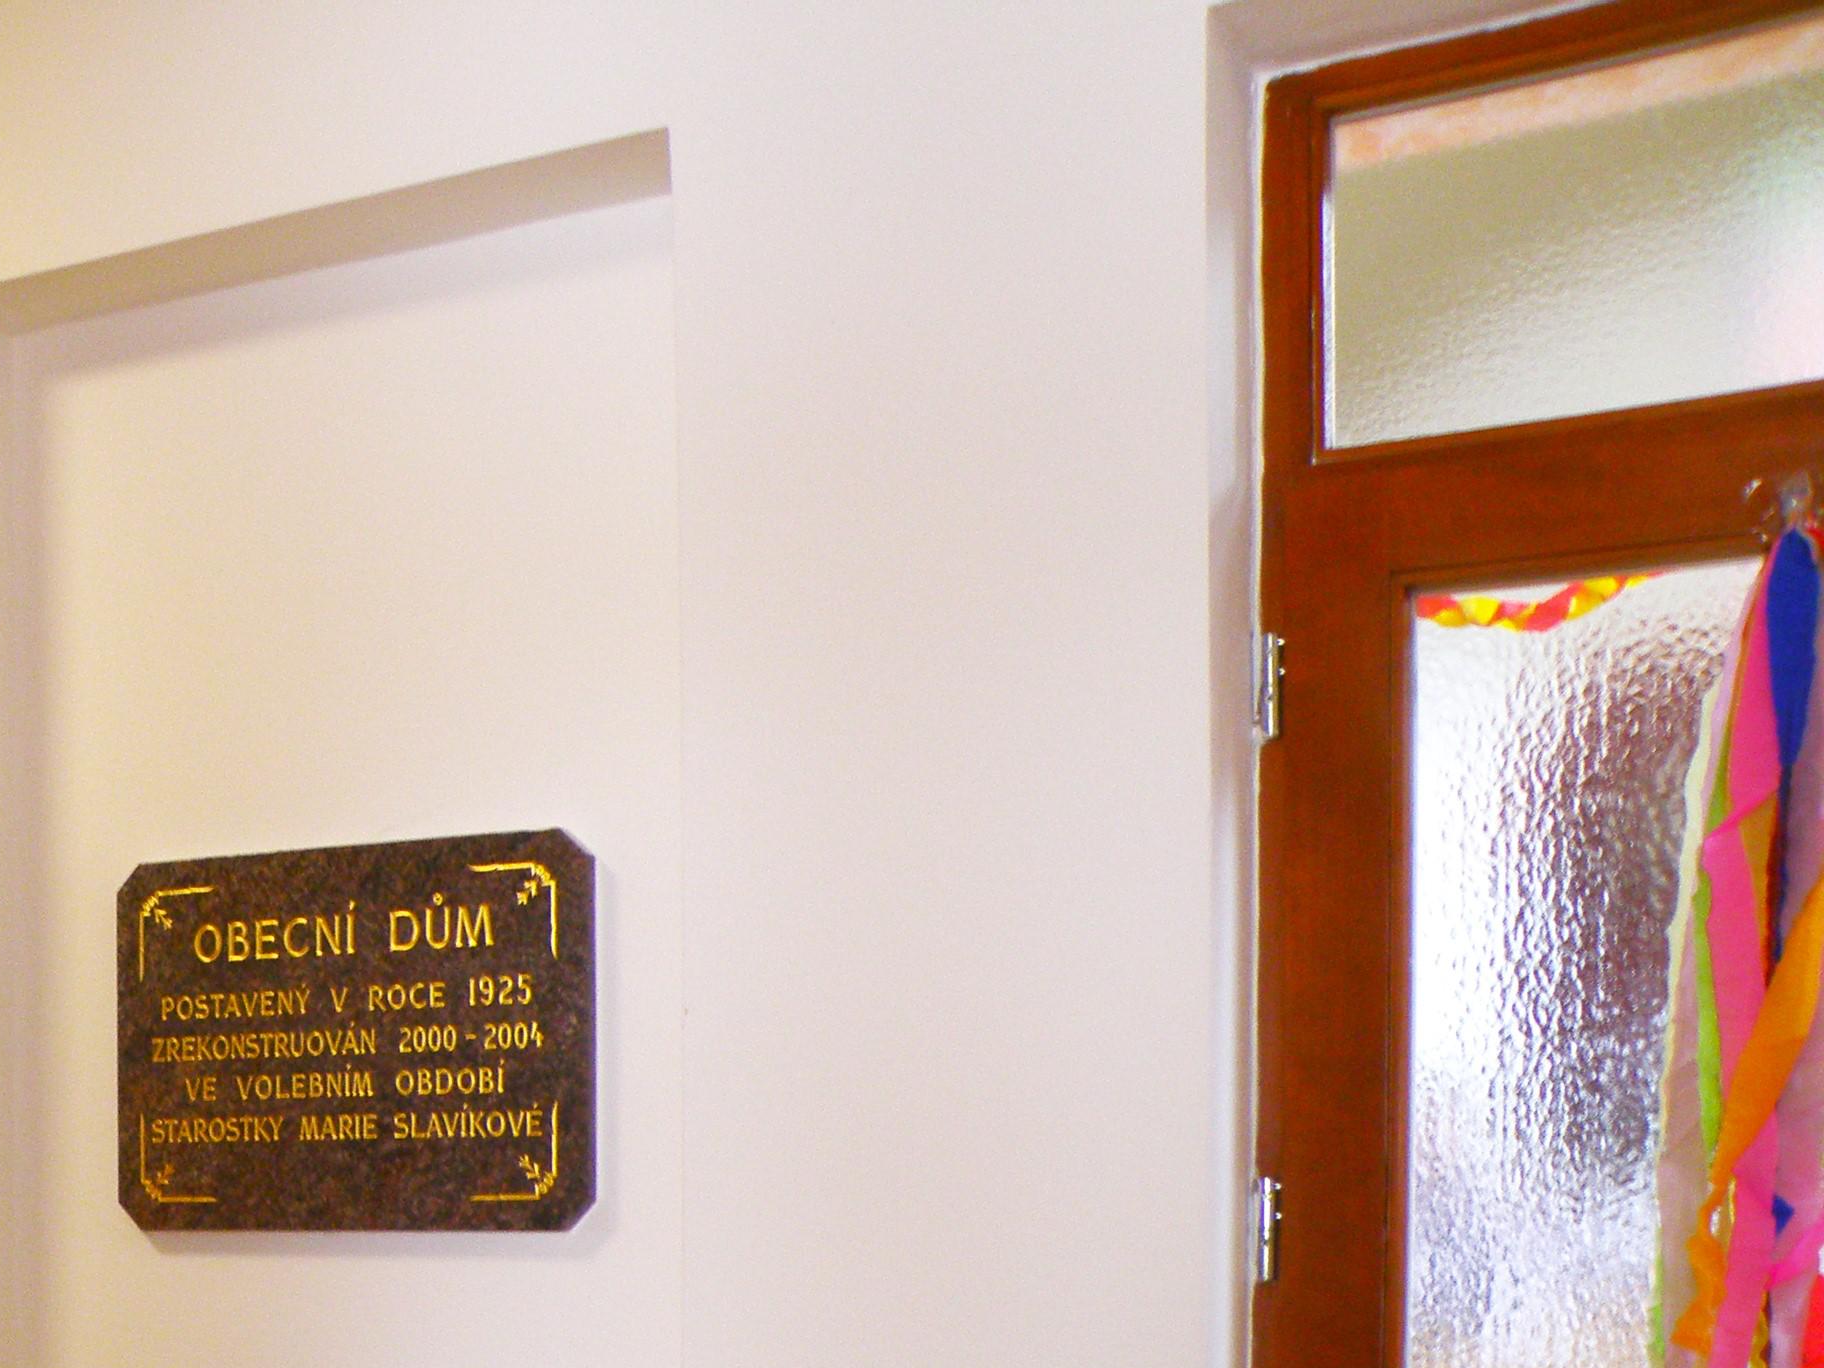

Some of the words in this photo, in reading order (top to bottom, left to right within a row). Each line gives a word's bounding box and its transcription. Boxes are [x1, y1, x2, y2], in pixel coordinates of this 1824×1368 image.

[194, 899, 357, 964] OBECNÍ
[388, 893, 494, 953] DŮM
[161, 983, 310, 1021] POSTAVENÝ
[331, 987, 348, 1013] V
[368, 981, 446, 1012] ROCE
[468, 974, 533, 1008] 1925
[151, 1023, 377, 1063] ZREKONSTRUOVÁN
[398, 1024, 457, 1053] 2000
[483, 1021, 544, 1050] 2004
[185, 1076, 217, 1102] VE
[236, 1063, 374, 1101] VOLEBNÍM
[395, 1059, 505, 1096] OBDOBÍ
[151, 1113, 283, 1144] STAROSTKY
[300, 1112, 378, 1140] MARIE
[394, 1102, 543, 1139] SLAVÍKOVÉ
